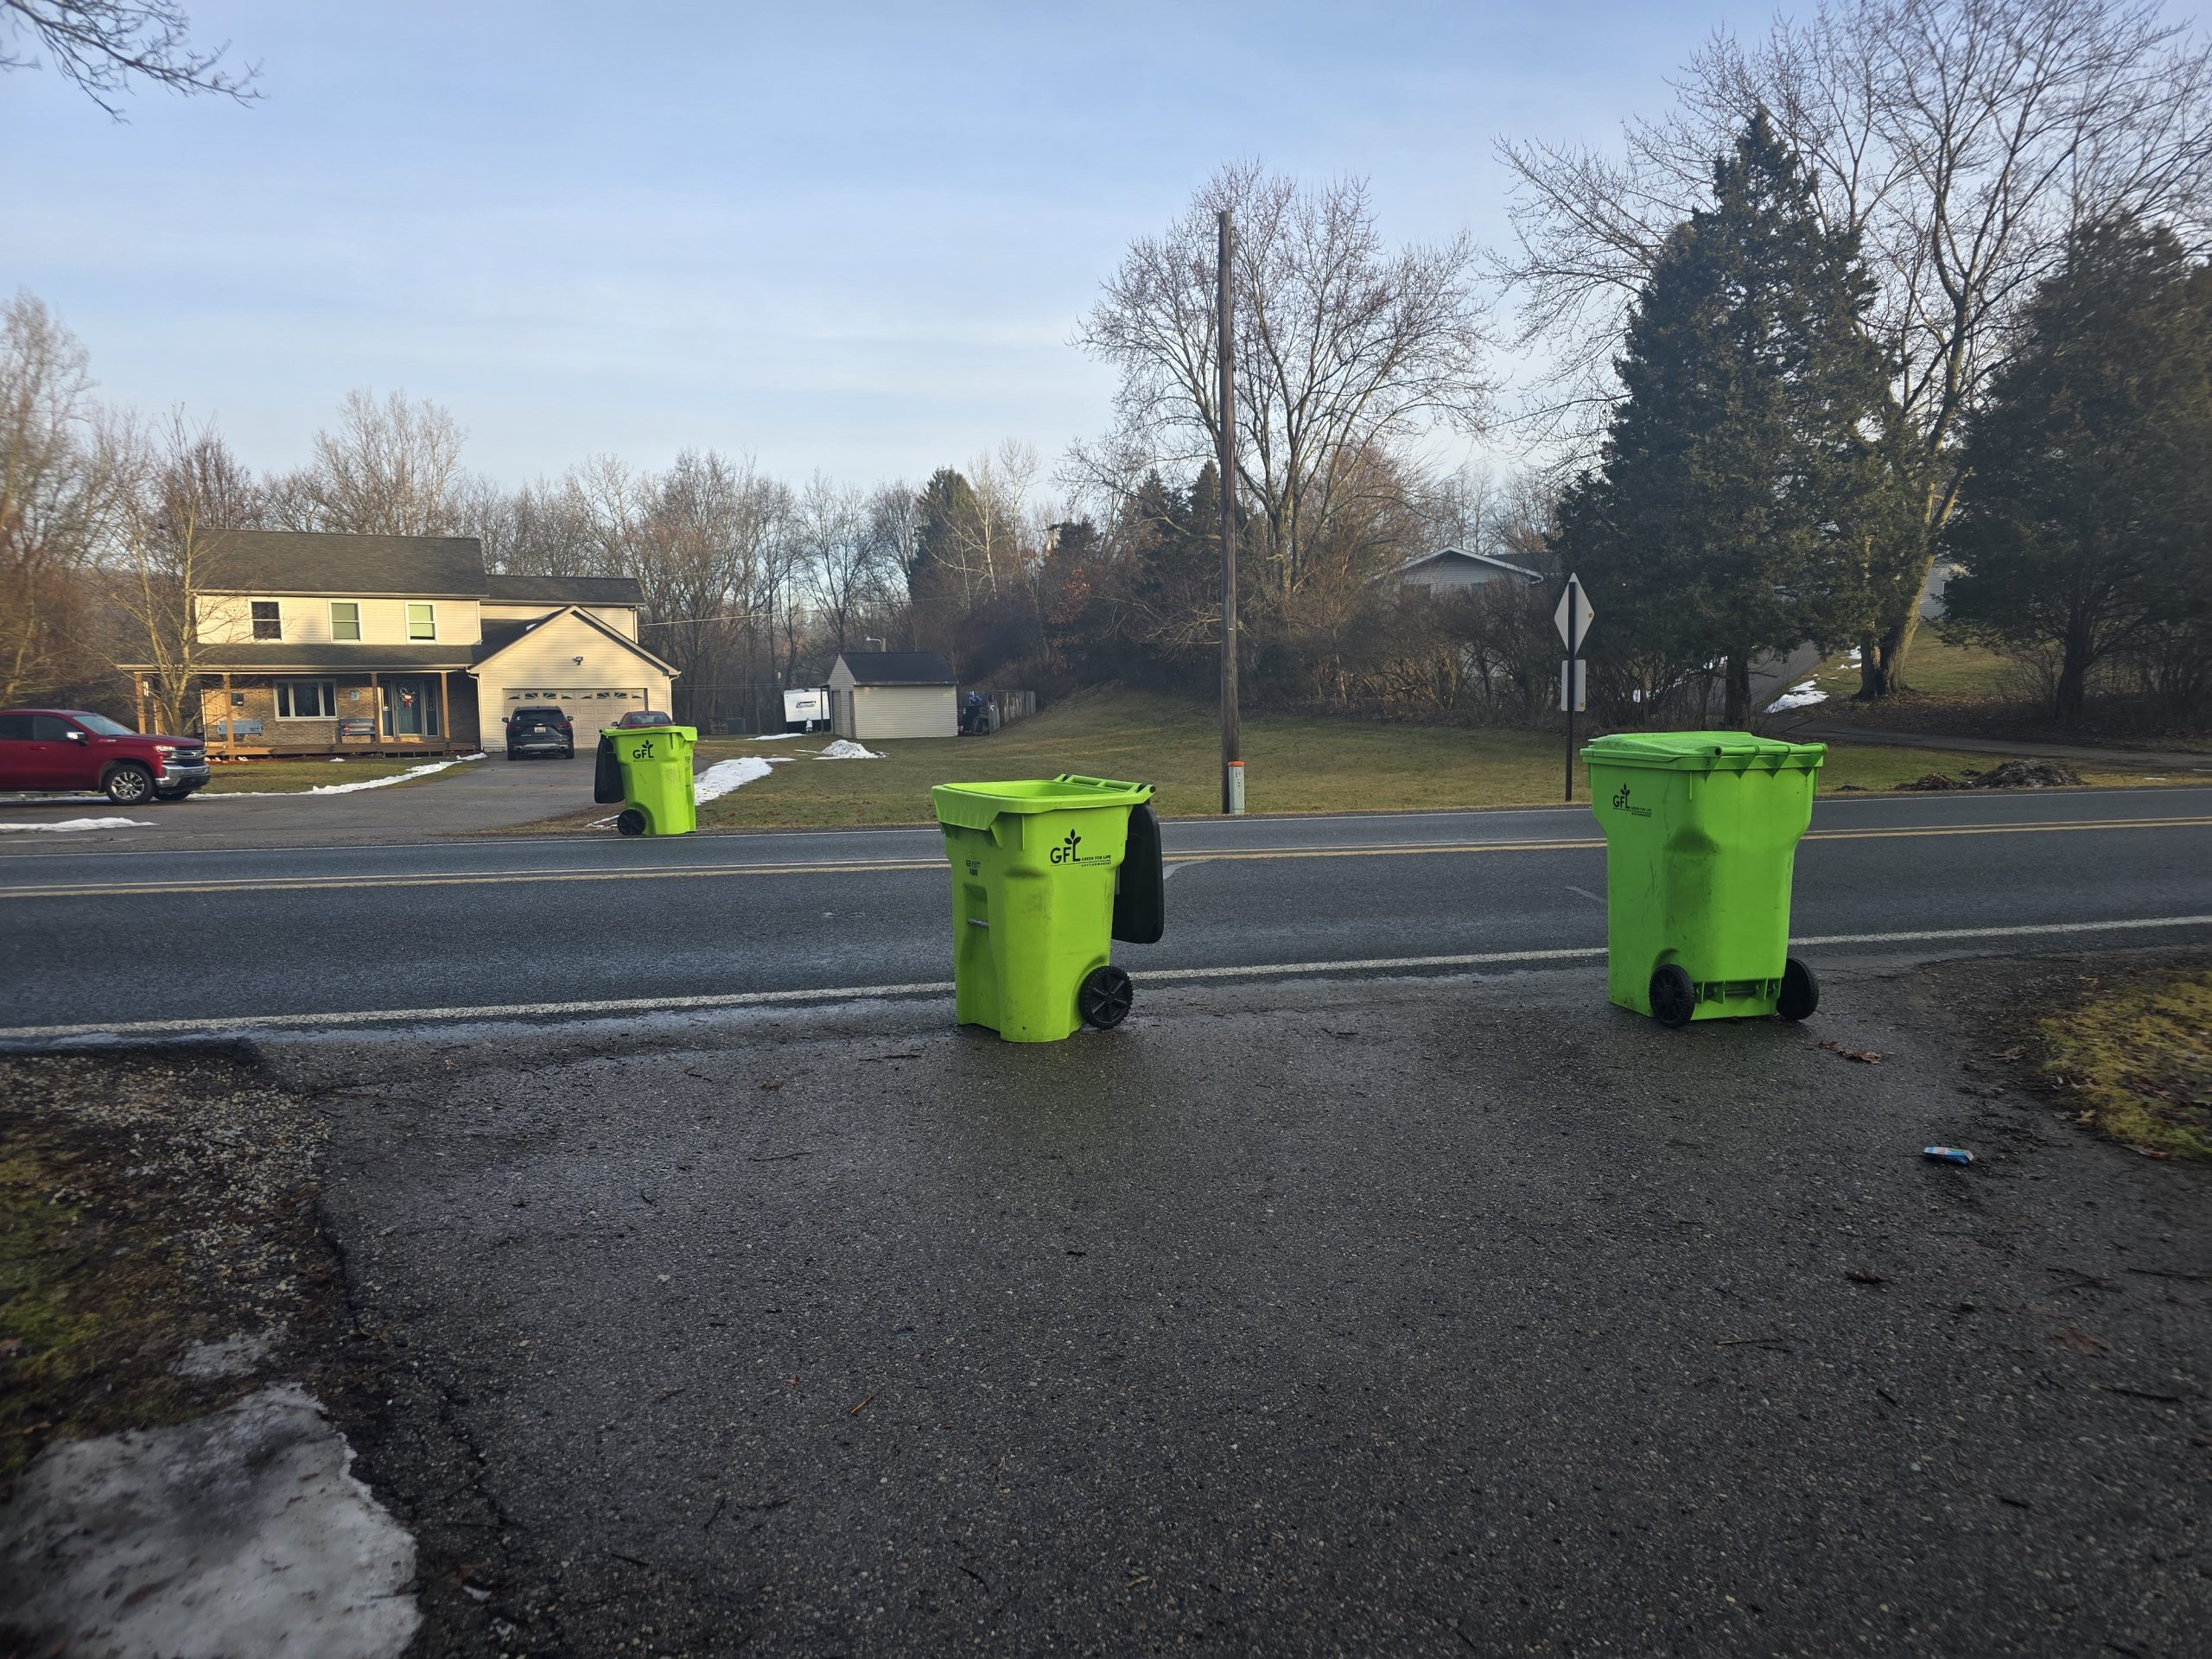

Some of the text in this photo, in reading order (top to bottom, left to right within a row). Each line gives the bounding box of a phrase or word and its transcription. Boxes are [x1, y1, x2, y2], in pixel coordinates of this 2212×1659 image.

[632, 745, 654, 759] GFL
[1612, 790, 1630, 809] GFL
[1050, 839, 1081, 864] GFL
